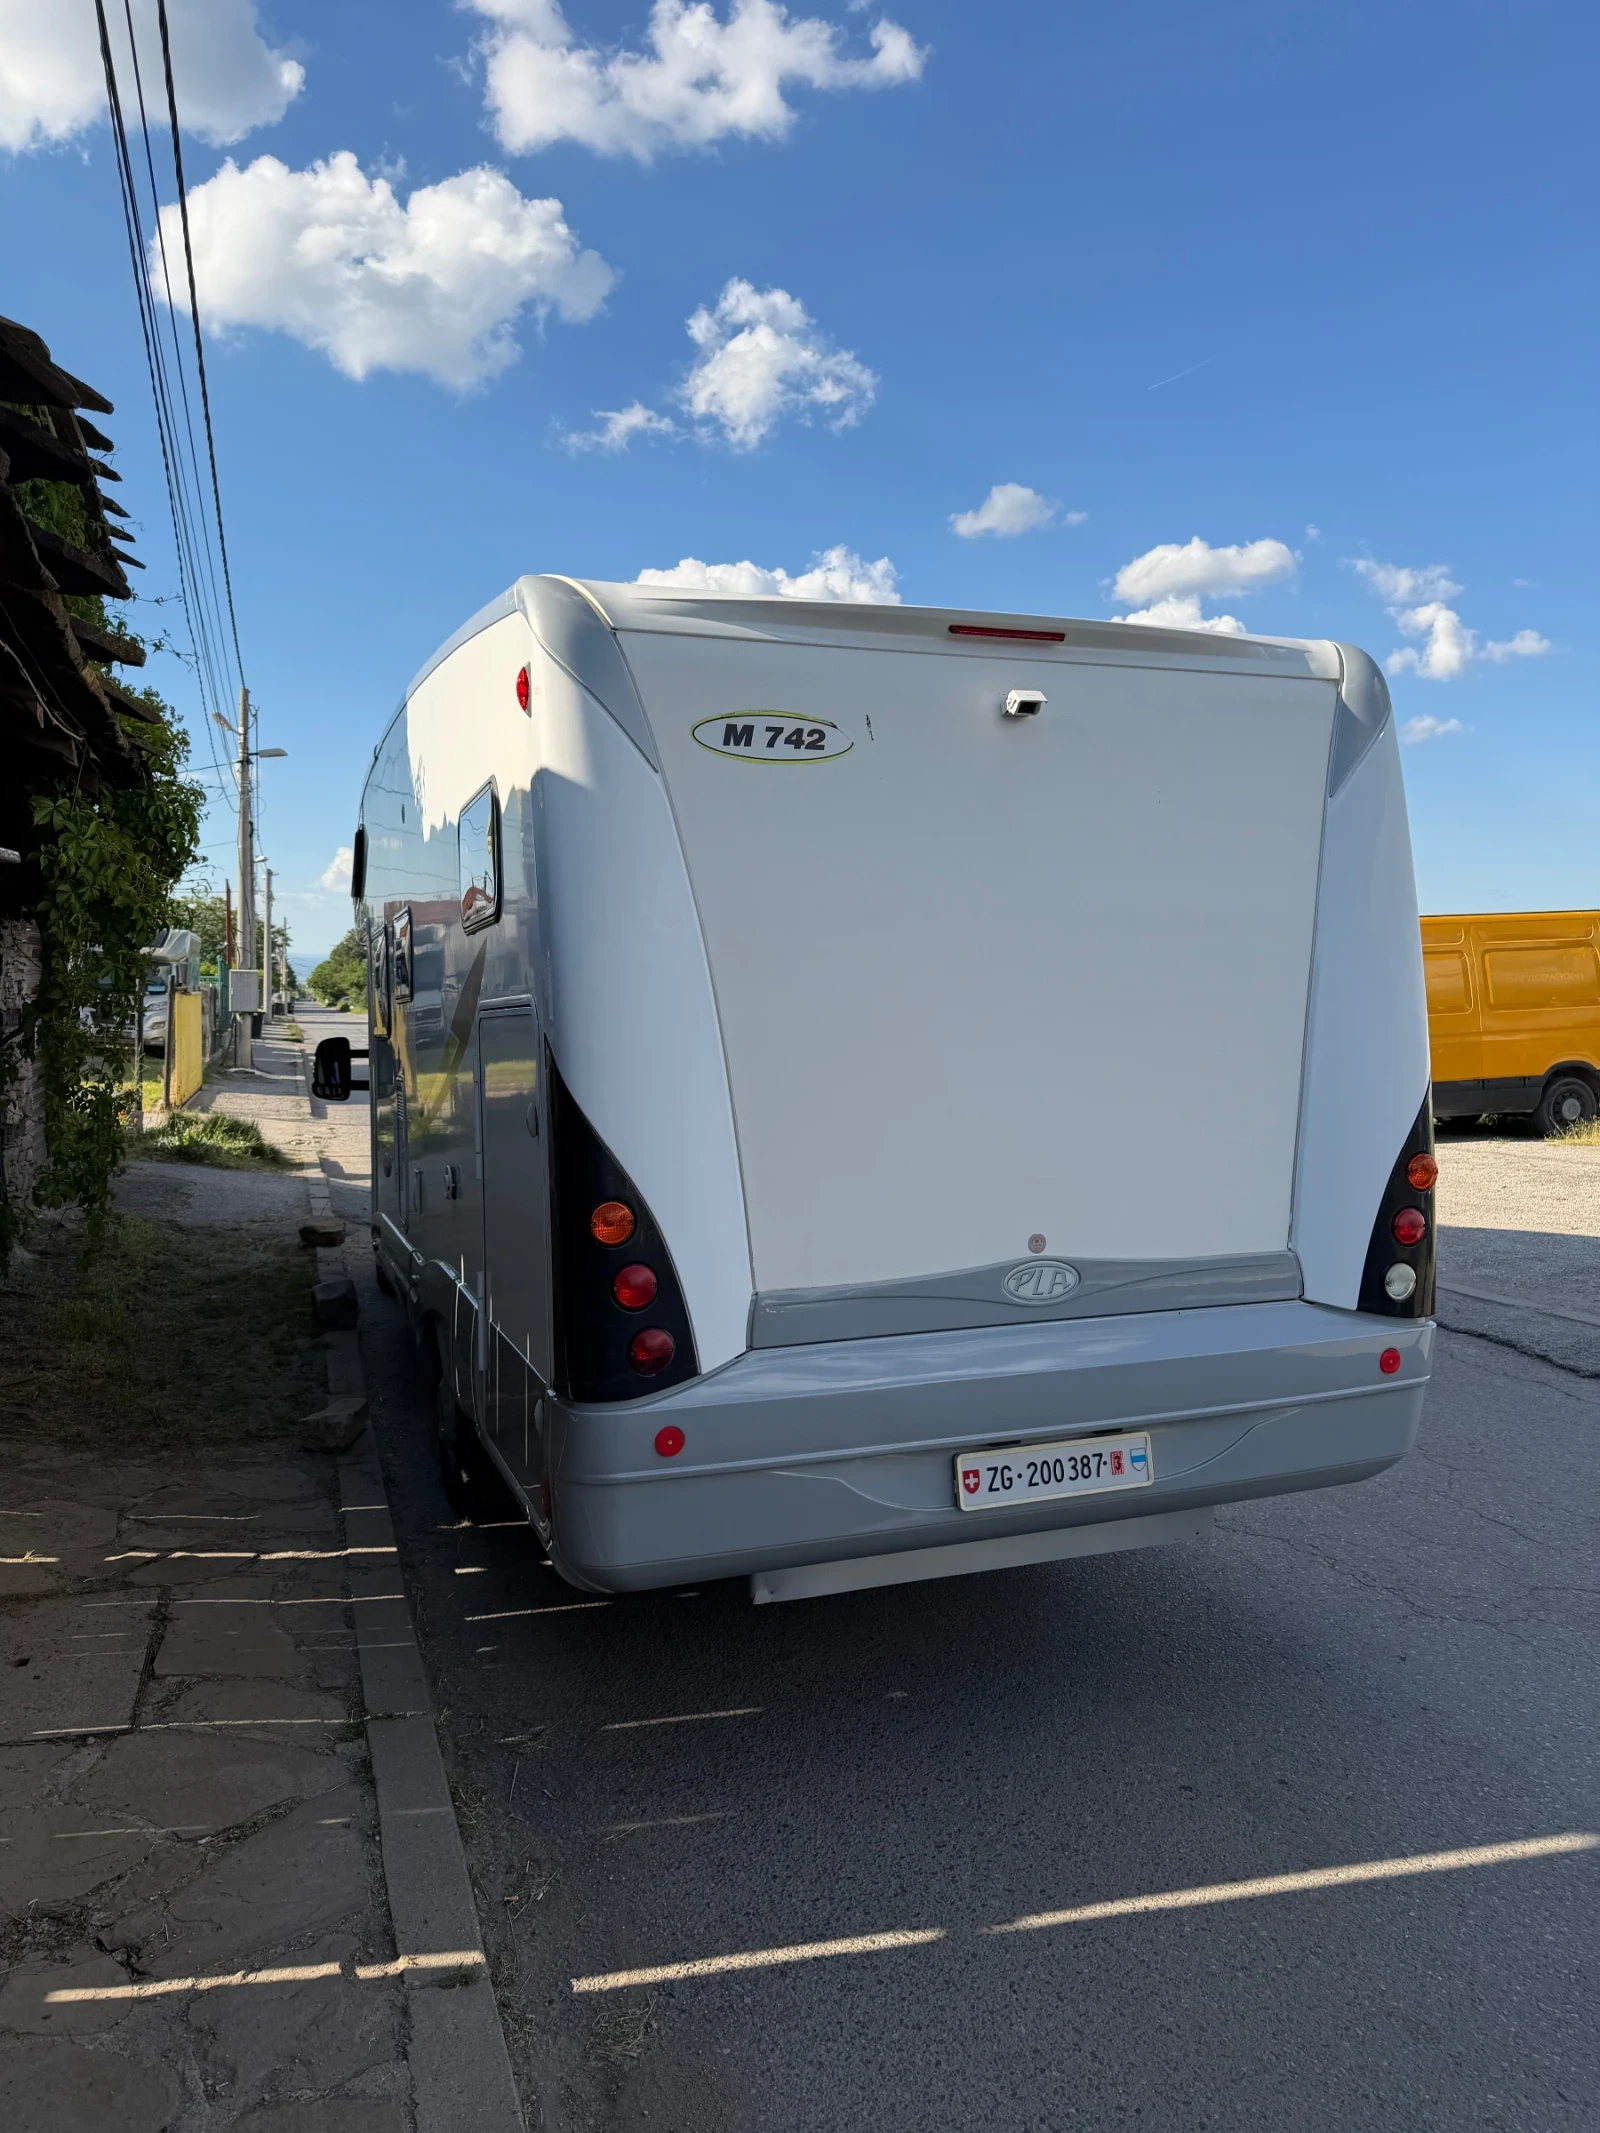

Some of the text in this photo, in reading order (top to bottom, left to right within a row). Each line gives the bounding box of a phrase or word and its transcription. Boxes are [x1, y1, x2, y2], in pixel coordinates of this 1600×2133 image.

[722, 723, 826, 751] M 742
[1505, 971, 1584, 984] Servicewagen
[1011, 1268, 1071, 1296] PLA
